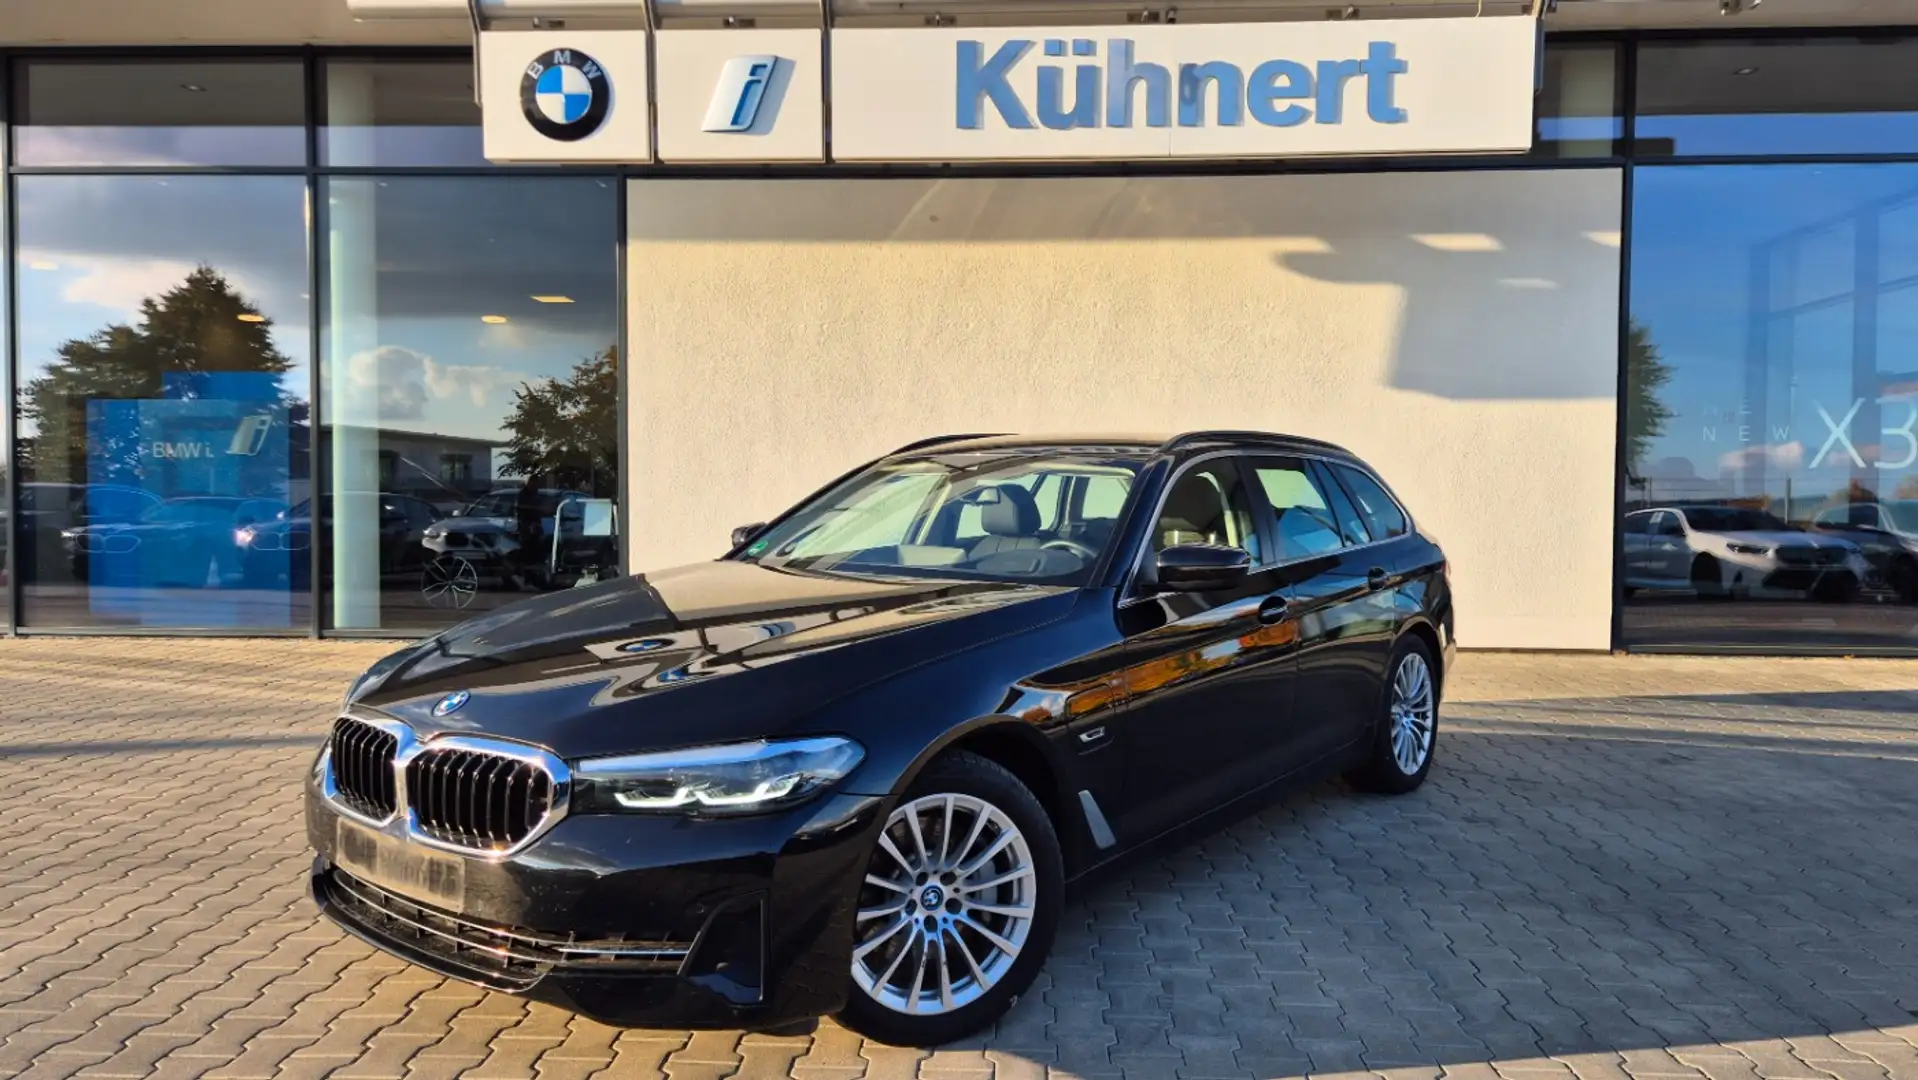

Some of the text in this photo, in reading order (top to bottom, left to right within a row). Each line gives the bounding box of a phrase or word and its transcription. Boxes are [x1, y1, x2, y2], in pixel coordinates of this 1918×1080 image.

[527, 50, 602, 79] BMW
[955, 38, 1409, 129] Kühnert
[1702, 424, 1790, 442] NEW
[1808, 396, 1918, 469] X3
[152, 442, 201, 459] BMW
